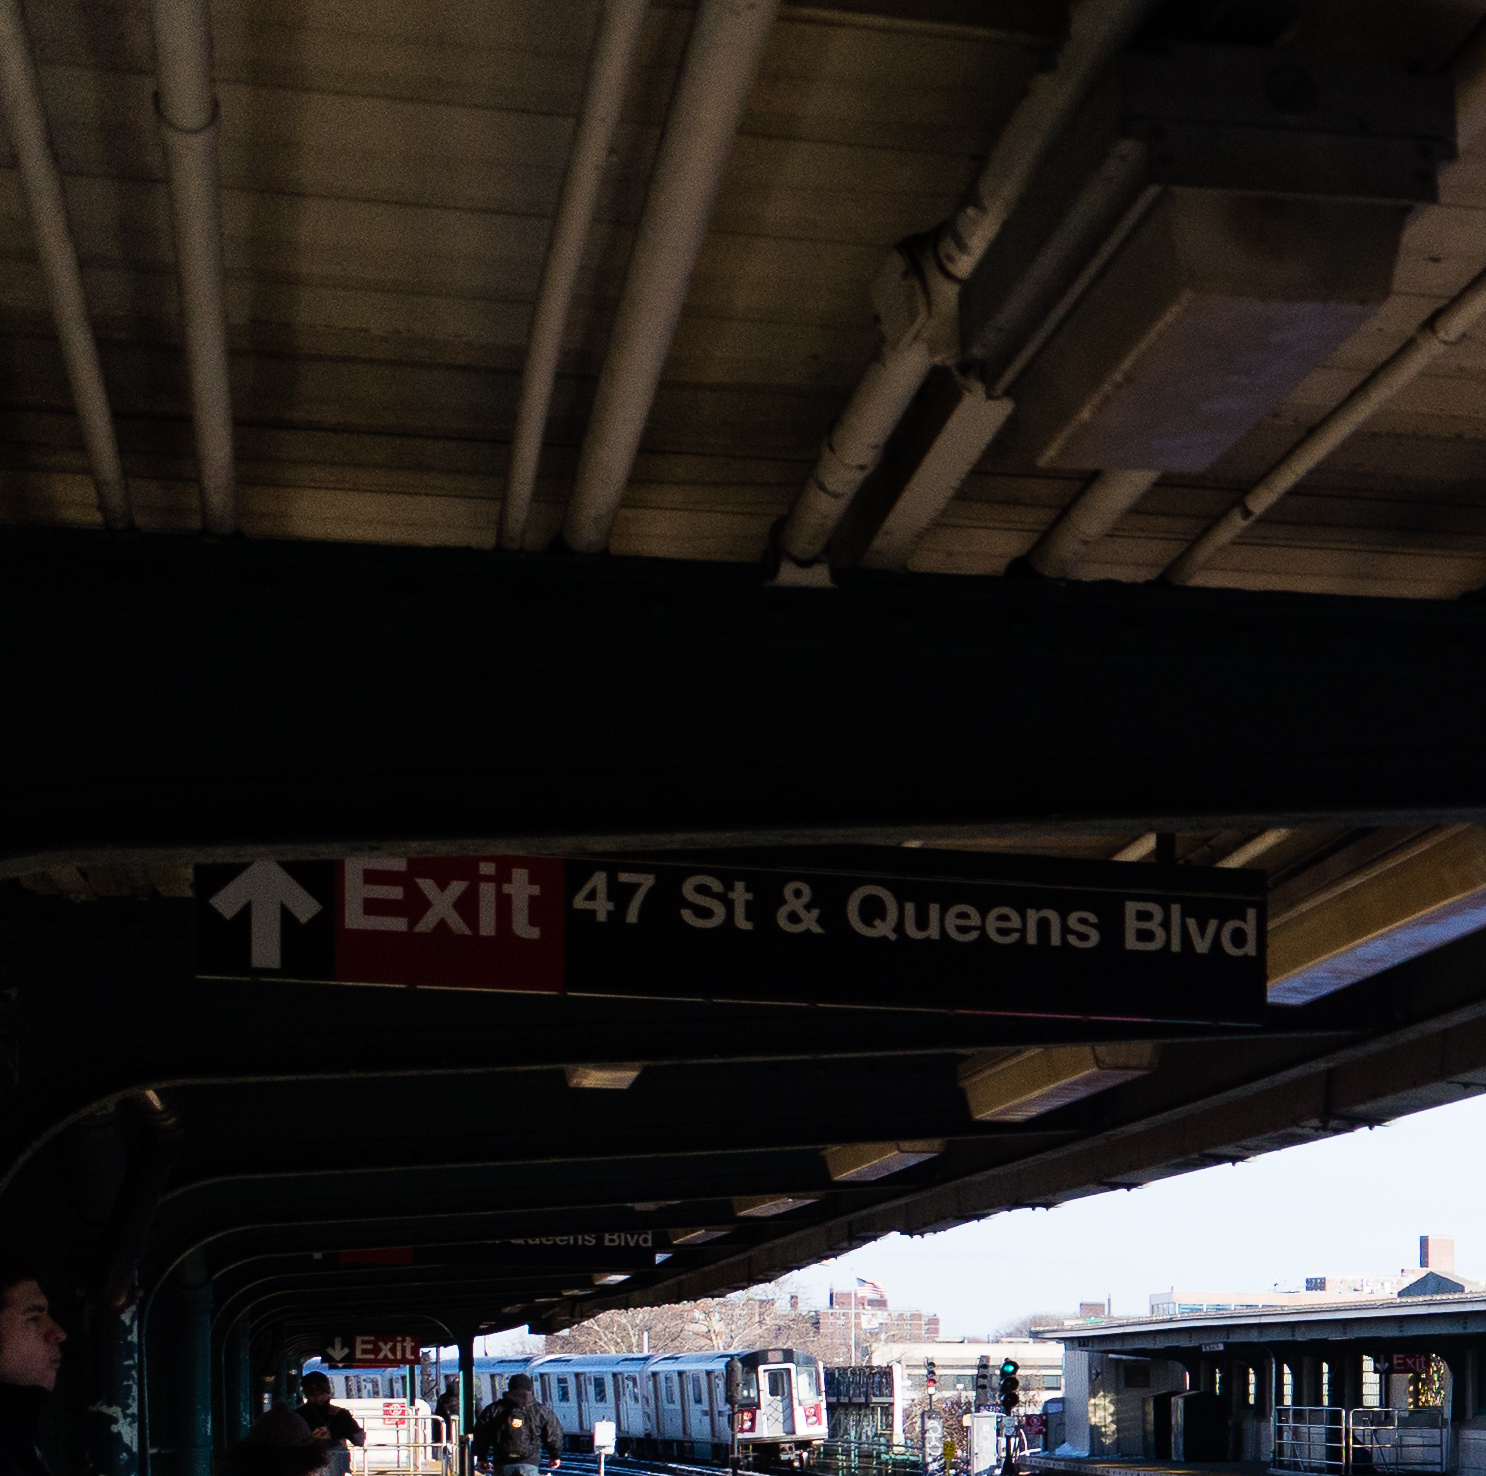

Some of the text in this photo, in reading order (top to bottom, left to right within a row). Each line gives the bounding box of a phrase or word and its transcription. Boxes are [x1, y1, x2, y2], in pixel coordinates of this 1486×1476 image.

[344, 857, 1259, 957] Exit 47 St & Queens Blvd
[355, 1335, 416, 1360] Exit
[1393, 1354, 1427, 1370] Exit
